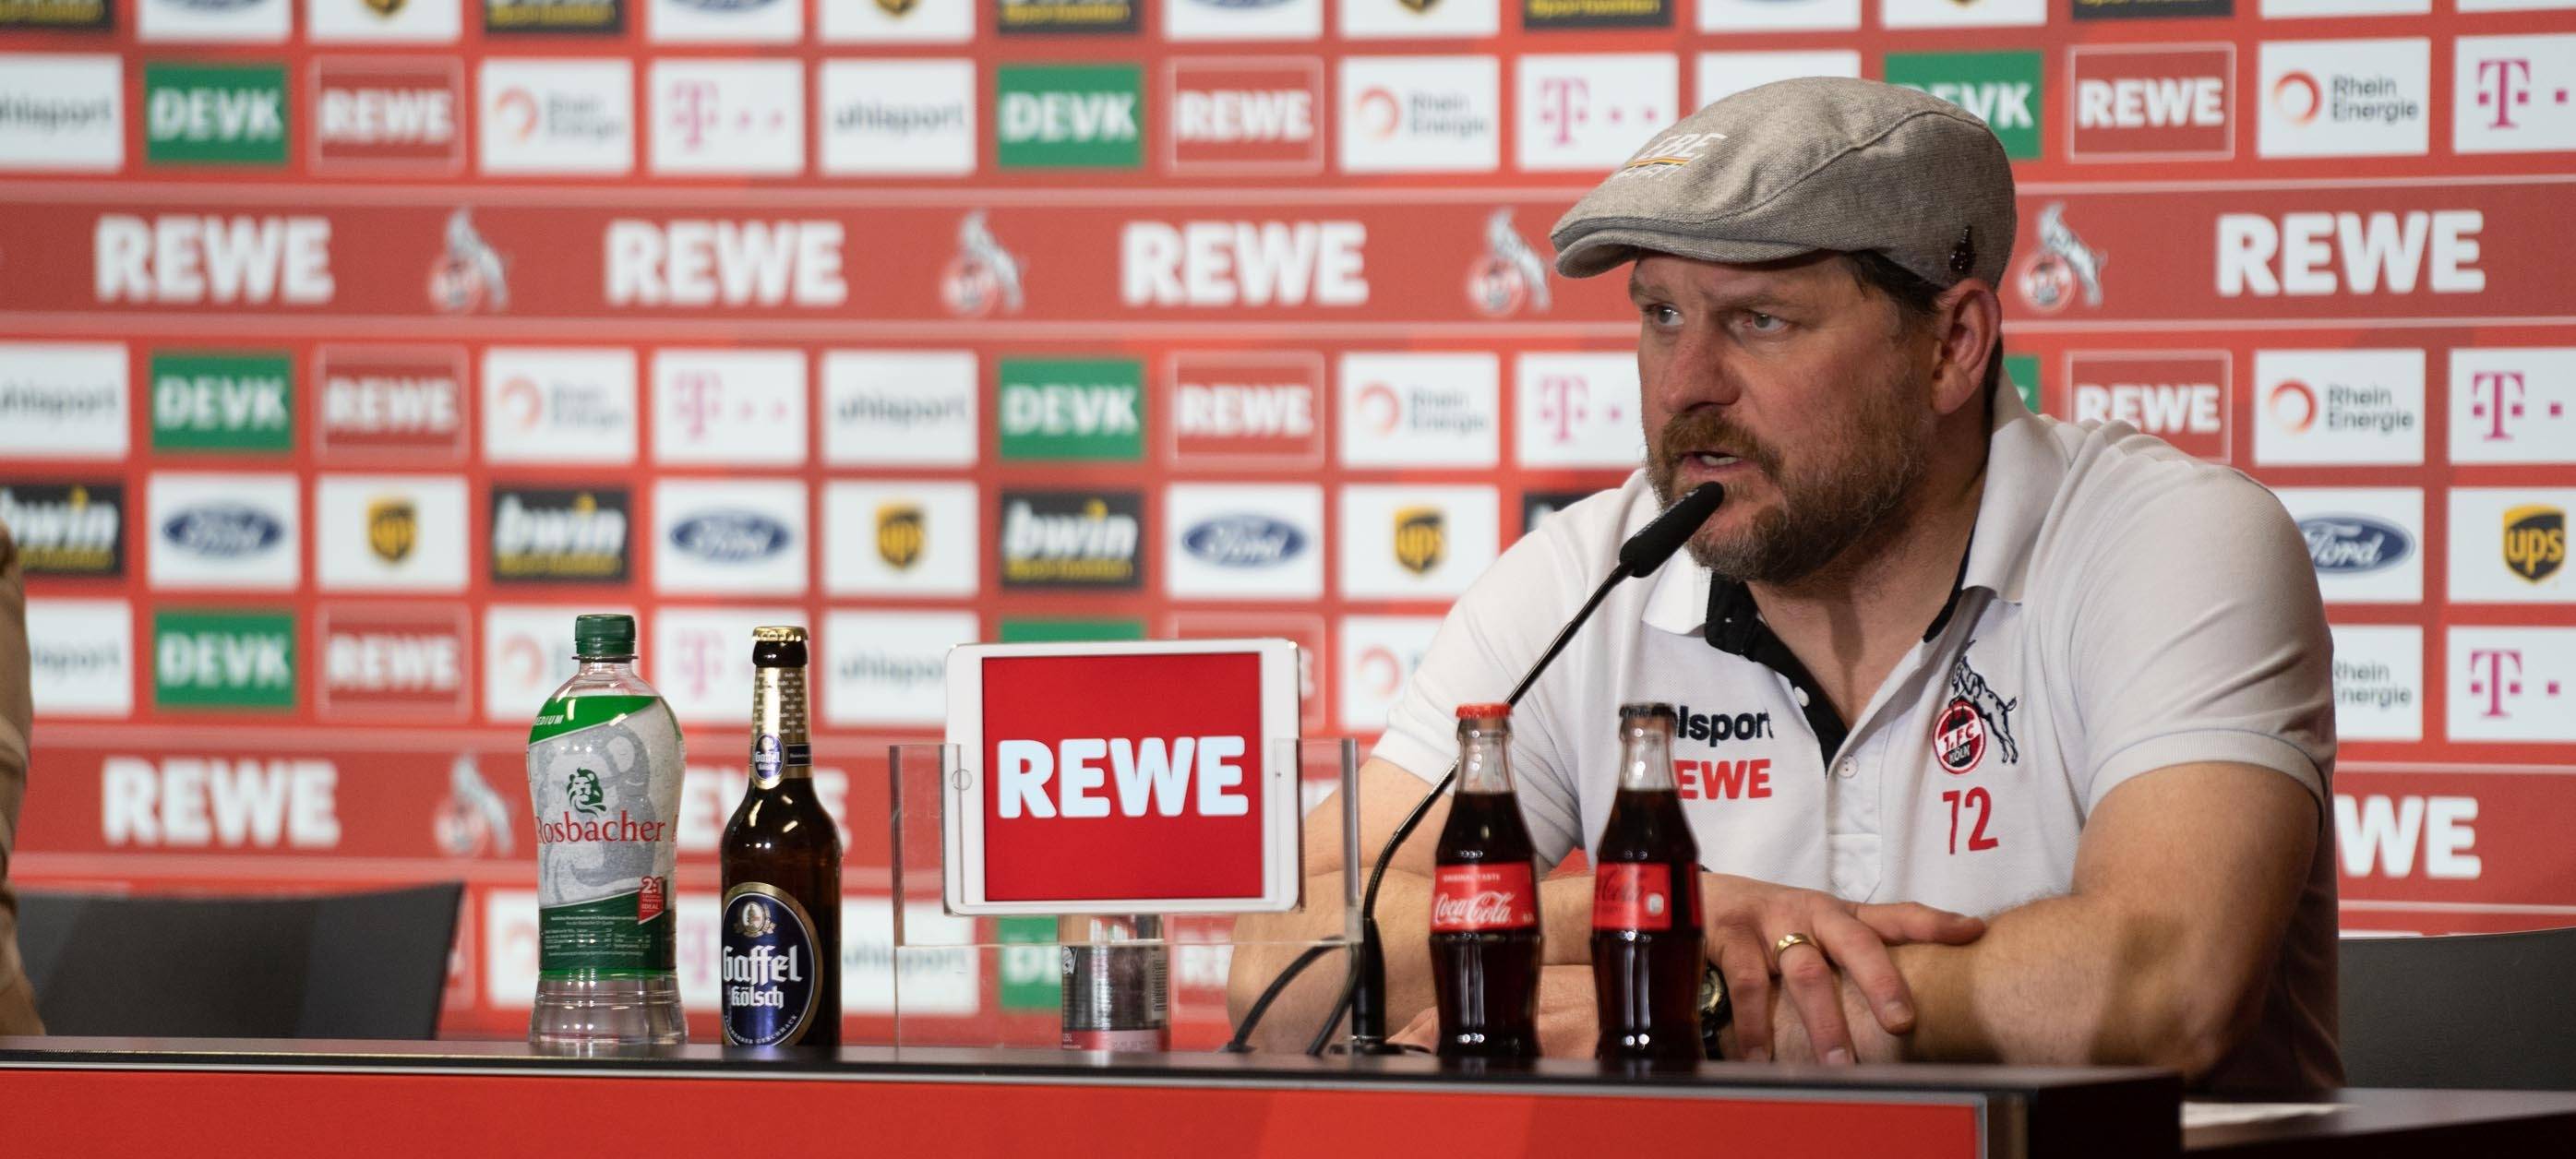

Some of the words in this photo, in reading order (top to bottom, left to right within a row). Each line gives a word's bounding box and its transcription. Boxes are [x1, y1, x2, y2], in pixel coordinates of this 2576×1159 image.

[2077, 78, 2225, 128] REWE
[2330, 75, 2398, 99] Rhein
[2330, 99, 2420, 125] Energie
[149, 88, 282, 141] DEVK
[319, 90, 456, 142] REWE
[999, 90, 1137, 142] DEVK
[1177, 90, 1313, 142] REWE
[94, 215, 335, 304] REWE
[605, 220, 847, 306] REWE
[1120, 221, 1370, 307] REWE
[2214, 209, 2486, 296] REWE
[154, 376, 289, 430] DEVK
[323, 376, 461, 433] REWE
[1000, 383, 1139, 436] DEVK
[1176, 382, 1313, 436] REWE
[2076, 383, 2221, 435] REWE
[2326, 383, 2394, 408] Rhein
[2326, 408, 2415, 436] Energie
[494, 495, 627, 556] bwin
[1003, 499, 1138, 560] bwin
[2305, 522, 2385, 568] Ford
[2508, 527, 2564, 573] ups
[156, 632, 291, 687] DEVK
[327, 632, 462, 690] REWE
[102, 758, 341, 849] REWE
[997, 735, 1250, 818] REWE
[1673, 758, 1774, 801] EWE
[1942, 786, 1999, 855] 72
[2333, 794, 2483, 880] WE
